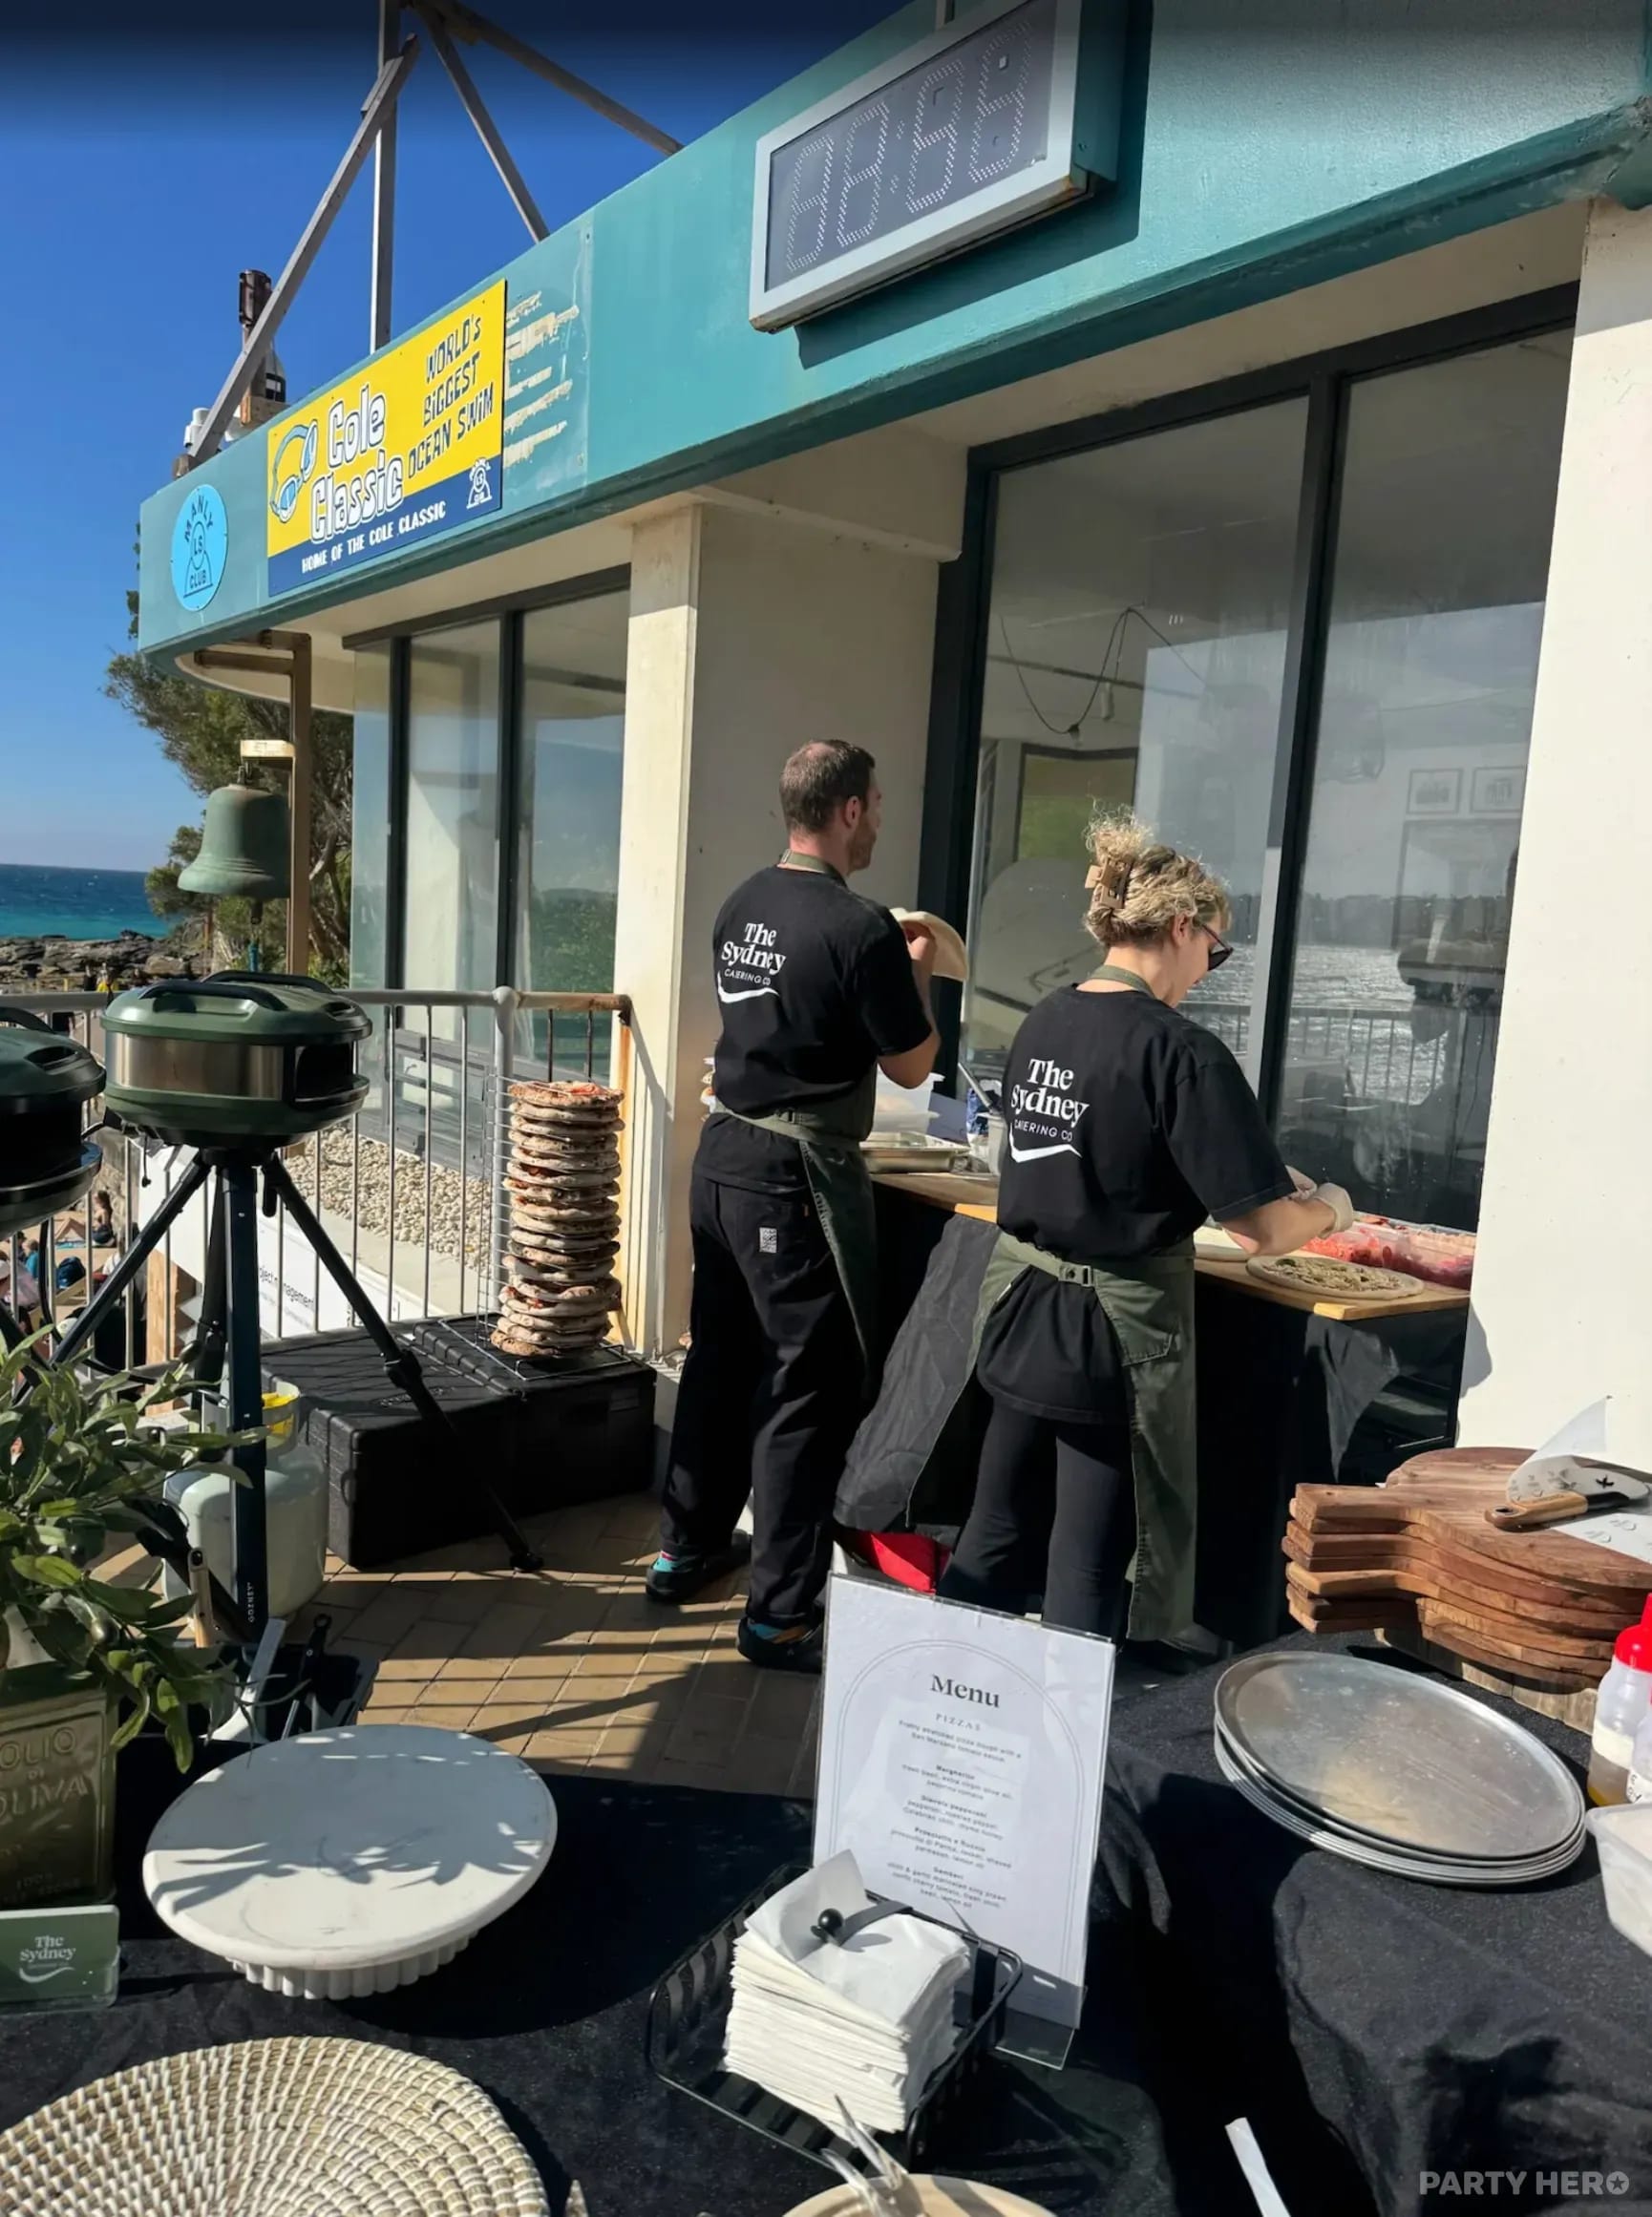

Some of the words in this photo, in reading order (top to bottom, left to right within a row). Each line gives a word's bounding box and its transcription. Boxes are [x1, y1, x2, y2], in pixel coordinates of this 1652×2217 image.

[328, 384, 386, 469] Cole
[408, 418, 451, 478] OCEAN
[310, 449, 404, 543] Classic
[184, 495, 214, 542] MANLY
[302, 549, 328, 573] HOME
[330, 542, 344, 561] OF
[347, 533, 365, 555] THE
[369, 521, 394, 545] COLE
[398, 500, 447, 534] CLASSIC
[190, 569, 206, 589] CLUB
[743, 922, 777, 947] The
[721, 940, 787, 976] Sydney
[1027, 1058, 1074, 1090] The
[1010, 1084, 1090, 1129] Sydney
[930, 1674, 1000, 1708] Menu
[935, 1713, 982, 1732] PIZZAS
[0, 1726, 76, 1769] OLIO
[19, 1948, 76, 1963] Sydney
[34, 1935, 64, 1948] The
